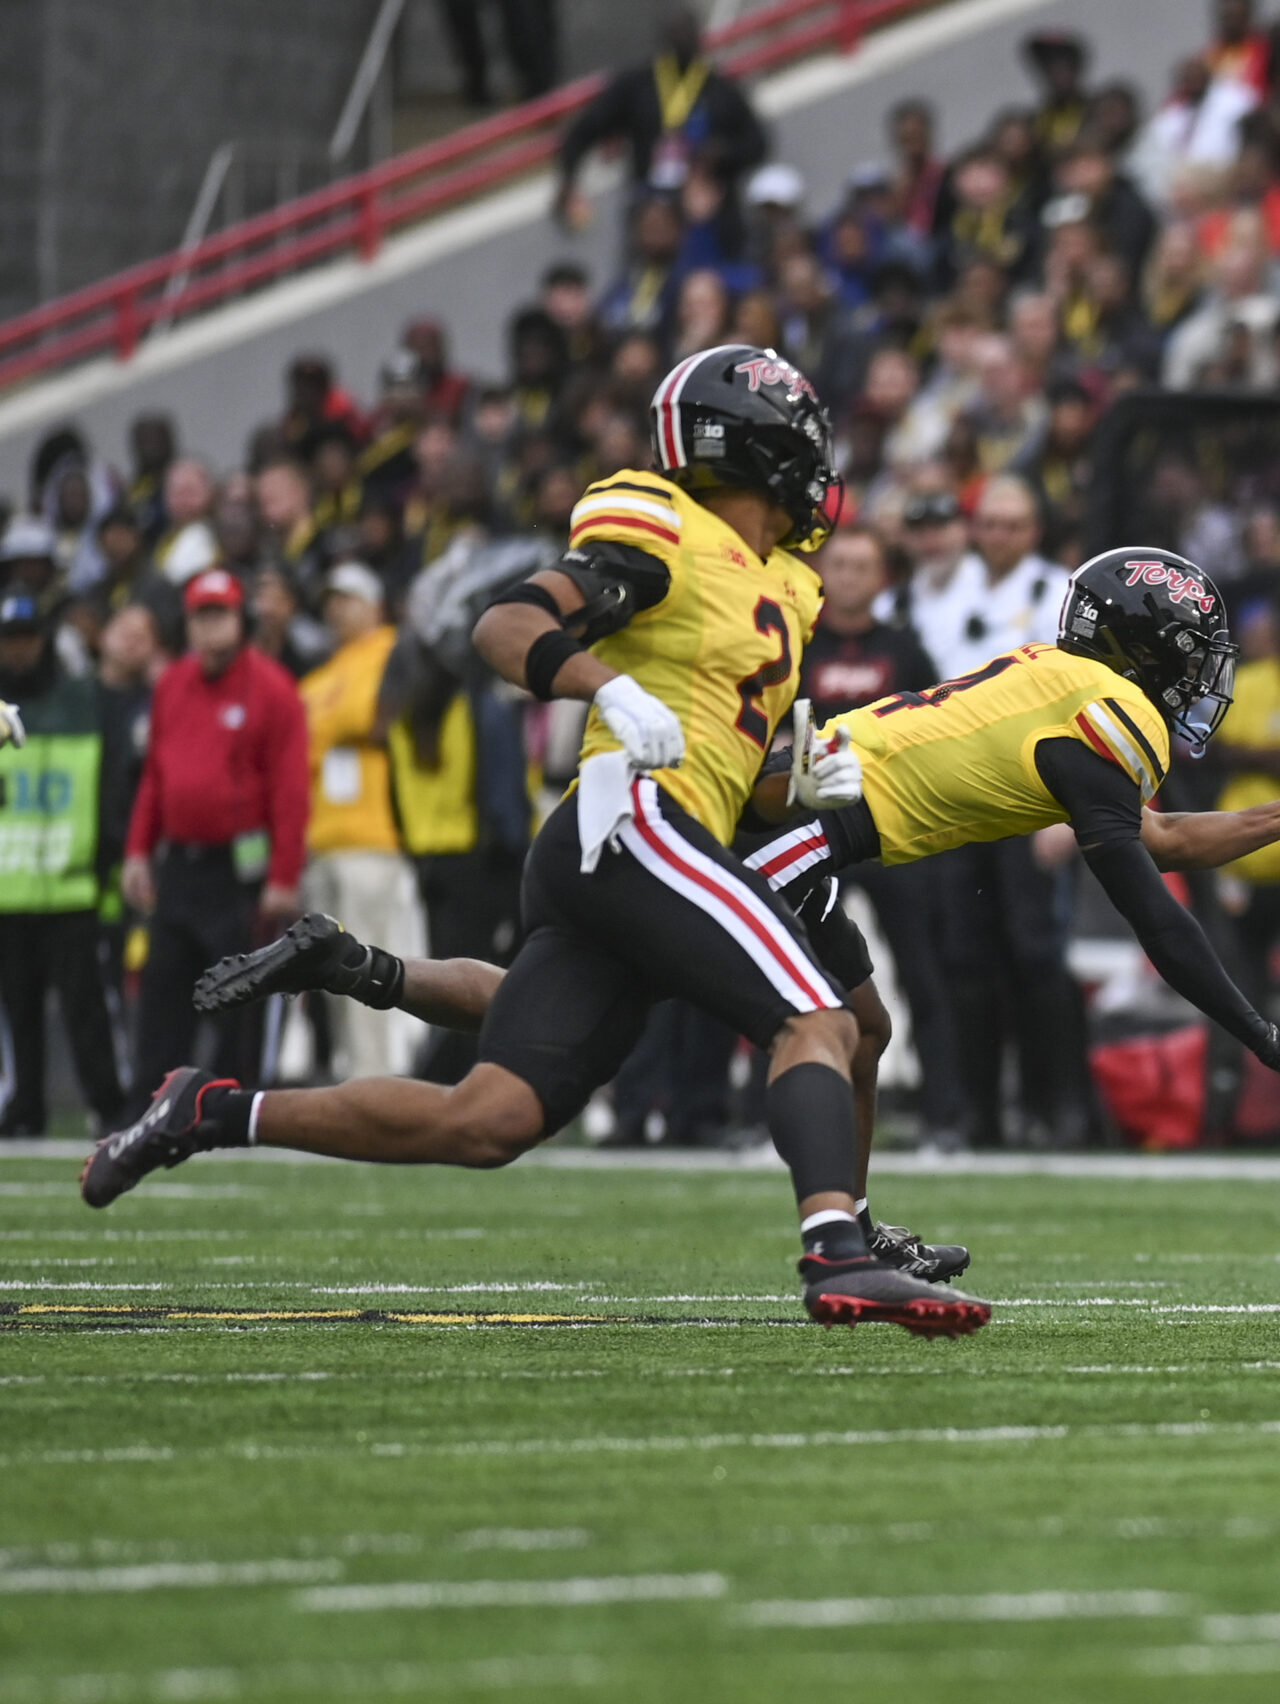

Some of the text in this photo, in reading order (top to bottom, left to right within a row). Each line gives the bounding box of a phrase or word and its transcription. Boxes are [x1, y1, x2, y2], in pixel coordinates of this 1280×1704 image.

[734, 357, 820, 404] Terp
[1124, 560, 1215, 614] Terps
[734, 594, 793, 751] 2
